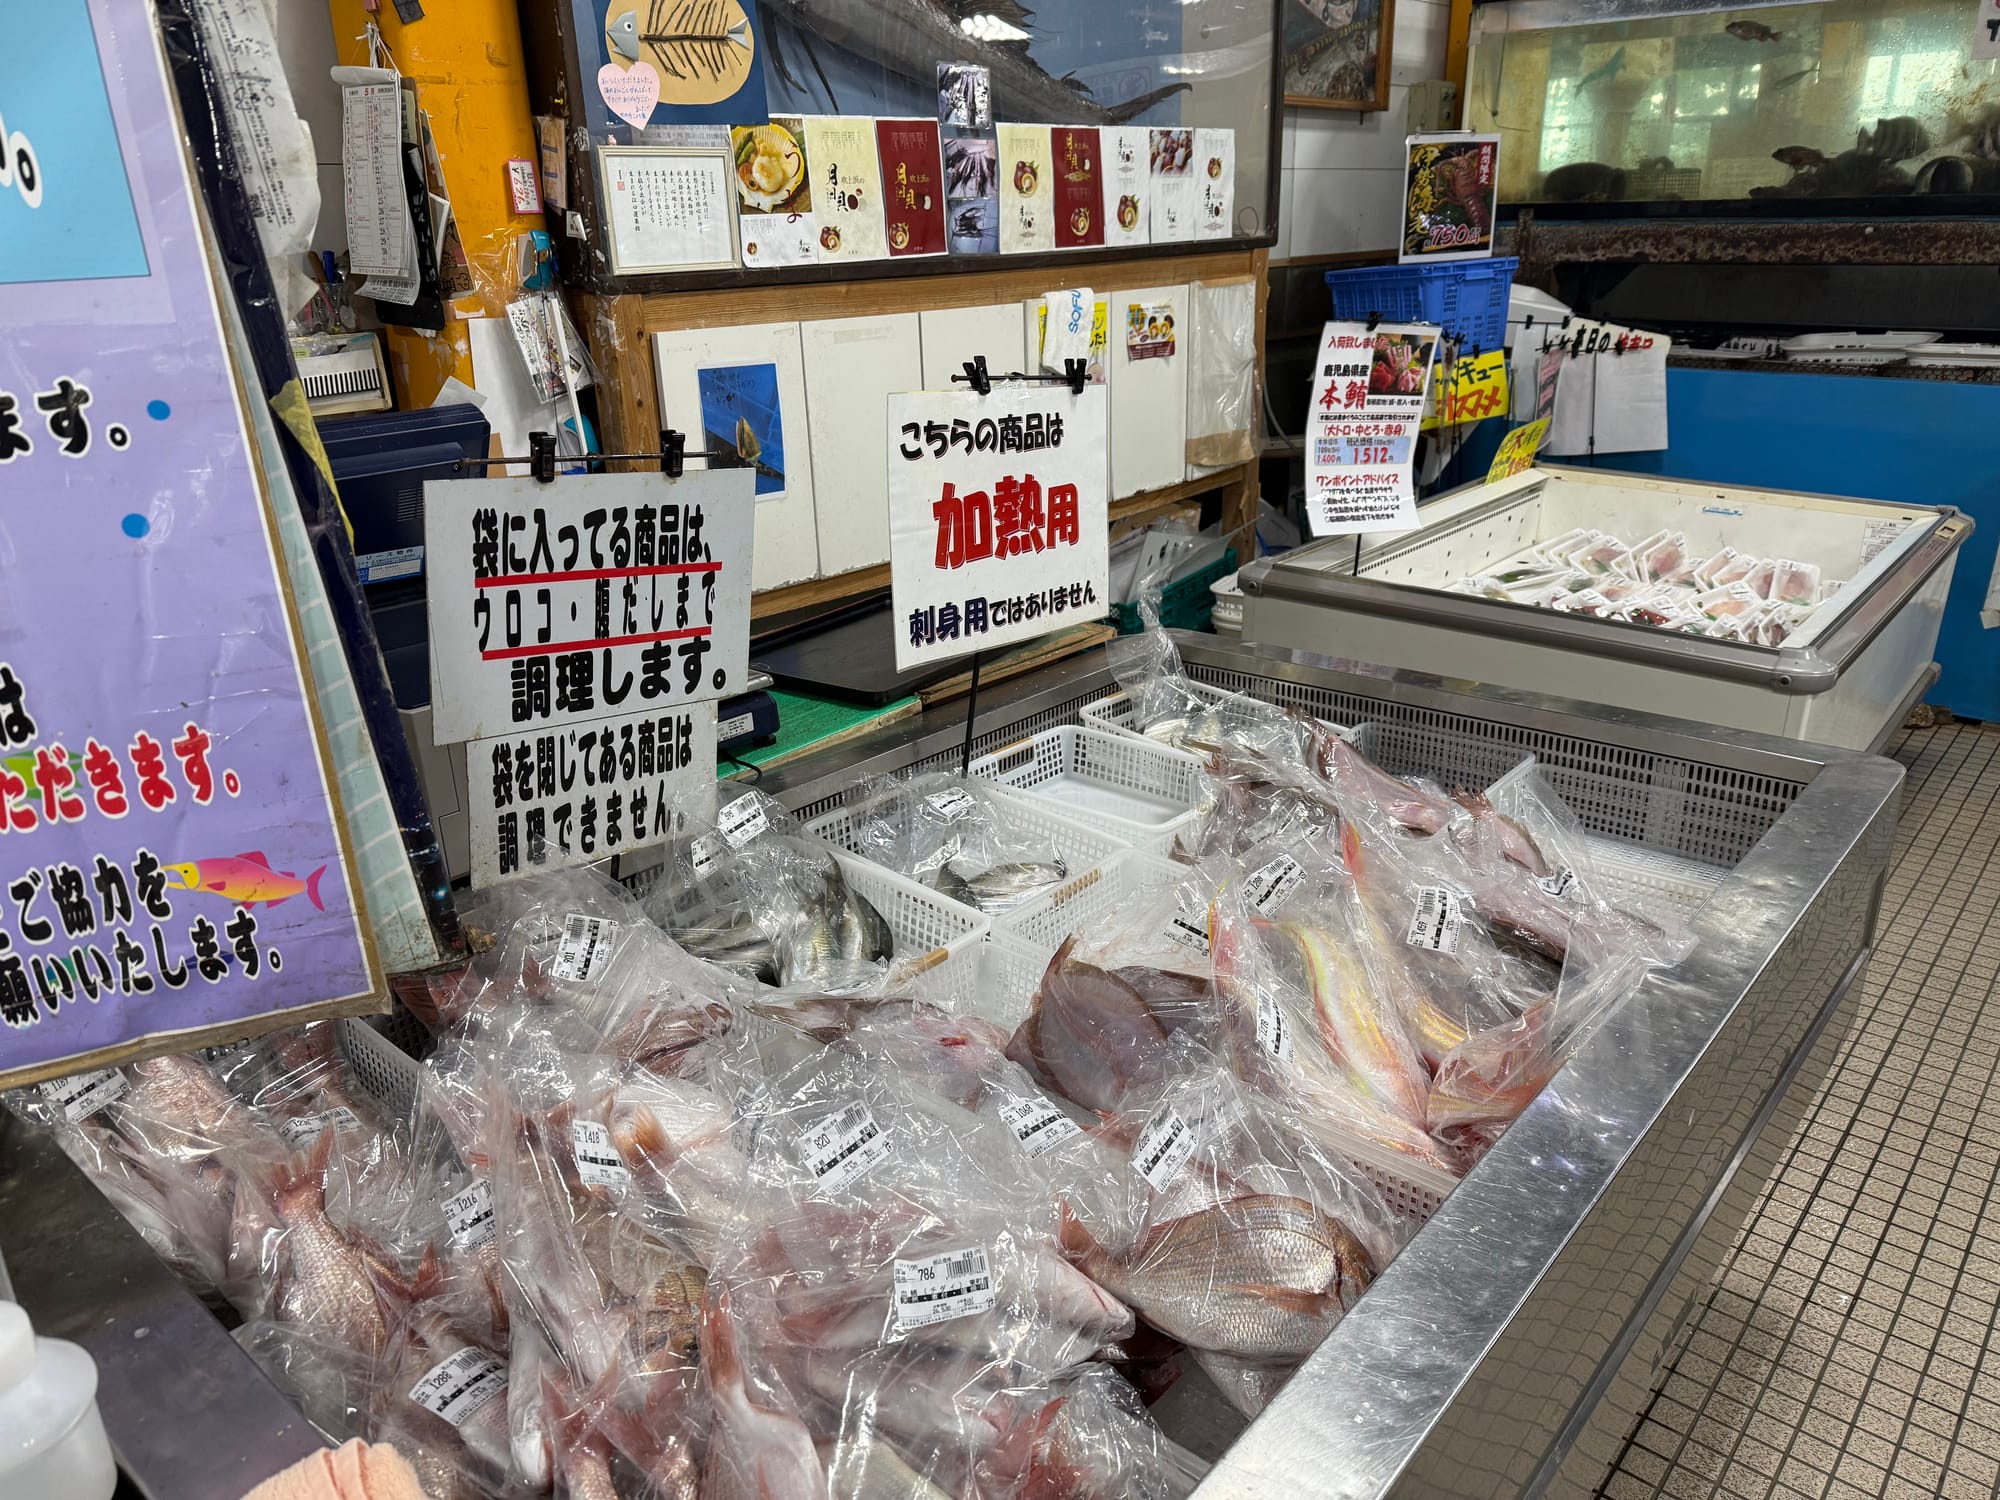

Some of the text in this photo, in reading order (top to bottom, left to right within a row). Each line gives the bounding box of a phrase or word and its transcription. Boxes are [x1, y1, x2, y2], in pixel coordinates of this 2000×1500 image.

[1319, 378, 1368, 411] 本鮪
[899, 411, 1065, 462] こちらの商品は
[1316, 472, 1400, 487] ワンポイントアドバイス
[472, 504, 713, 578] 袋に入ってる商品は、
[932, 473, 1080, 570] 加熱用
[473, 571, 717, 653] ウロコ・腹だしまで
[510, 635, 727, 723] 調理します。
[491, 713, 693, 809] 袋を閉じてある商品は
[0, 849, 172, 952] ご協力を
[813, 1133, 831, 1150] 820
[458, 1193, 478, 1212] 1216
[917, 1266, 936, 1281] 786
